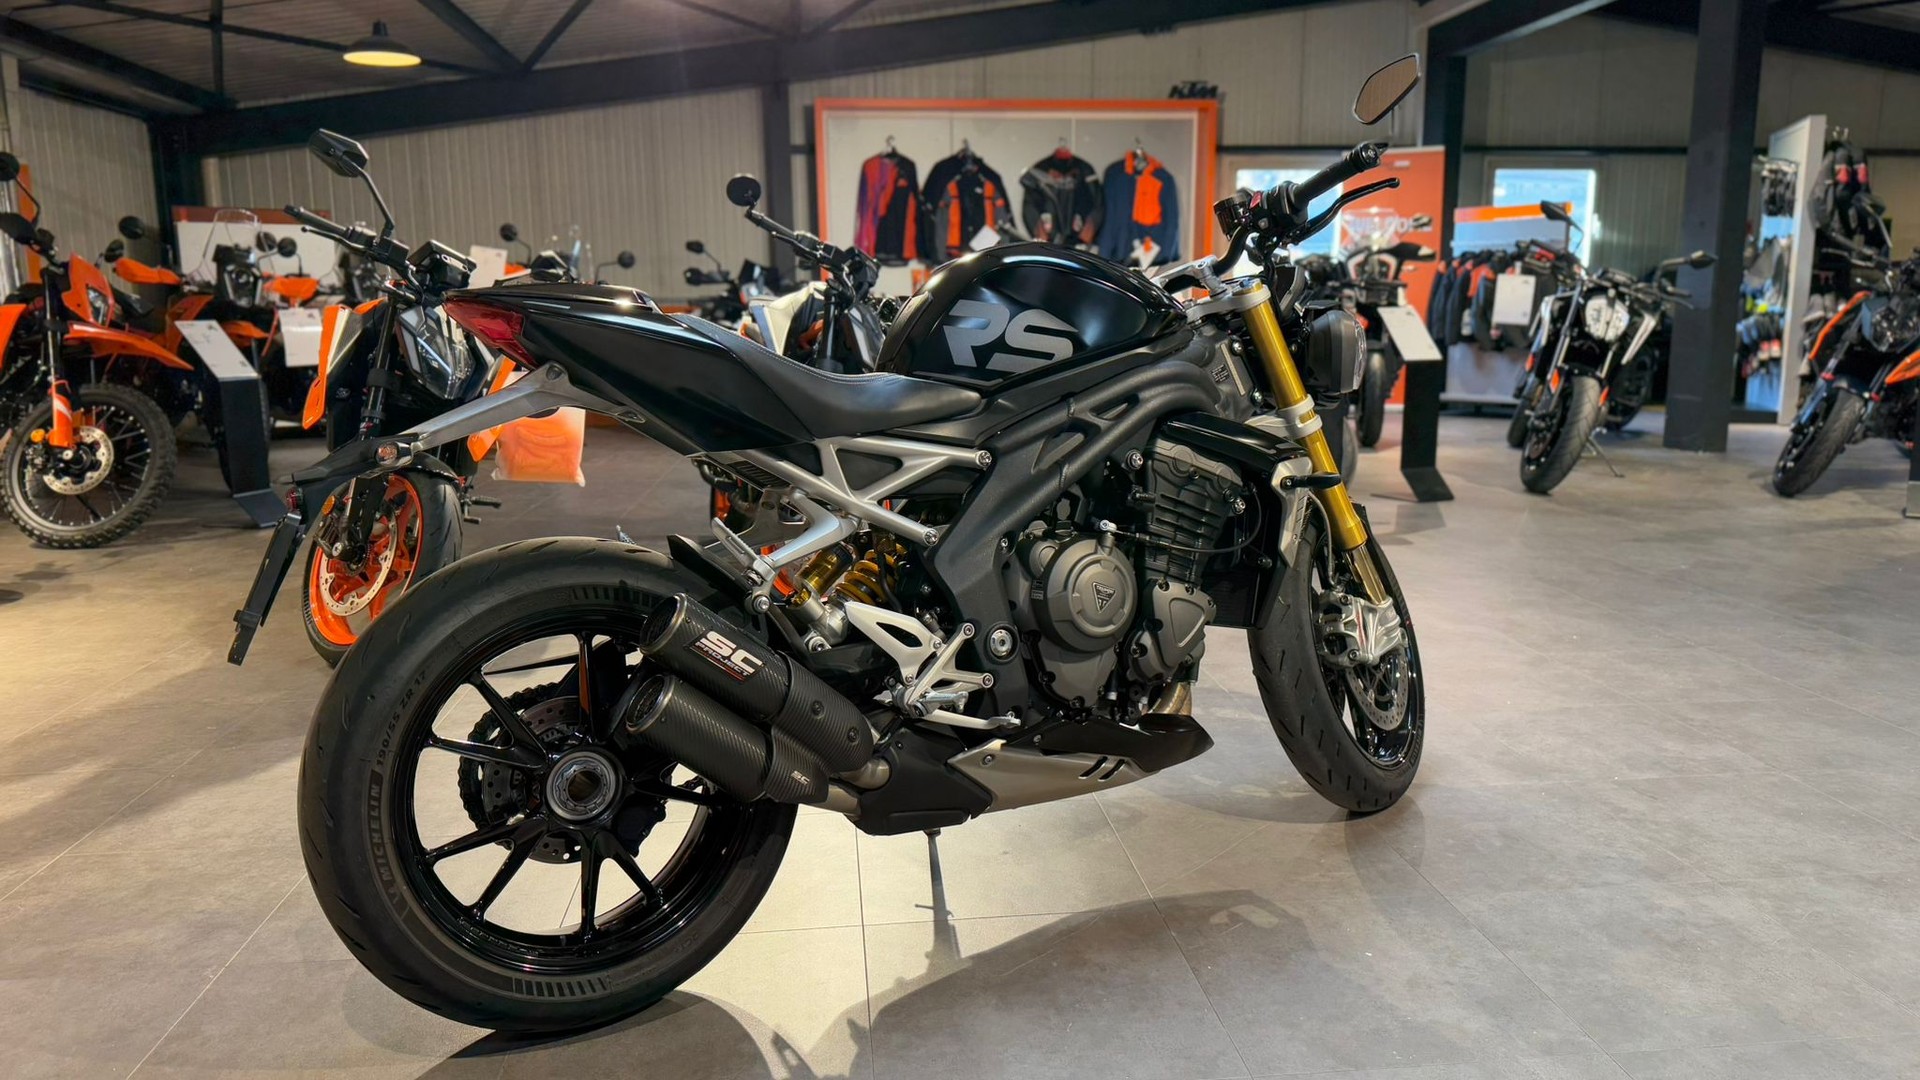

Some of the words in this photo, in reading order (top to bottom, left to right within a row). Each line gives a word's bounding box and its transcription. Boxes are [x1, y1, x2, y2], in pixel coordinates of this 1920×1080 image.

[943, 299, 1079, 373] RS
[694, 641, 751, 676] PROJECT
[700, 631, 763, 674] SC
[369, 783, 393, 882] MICHELIN
